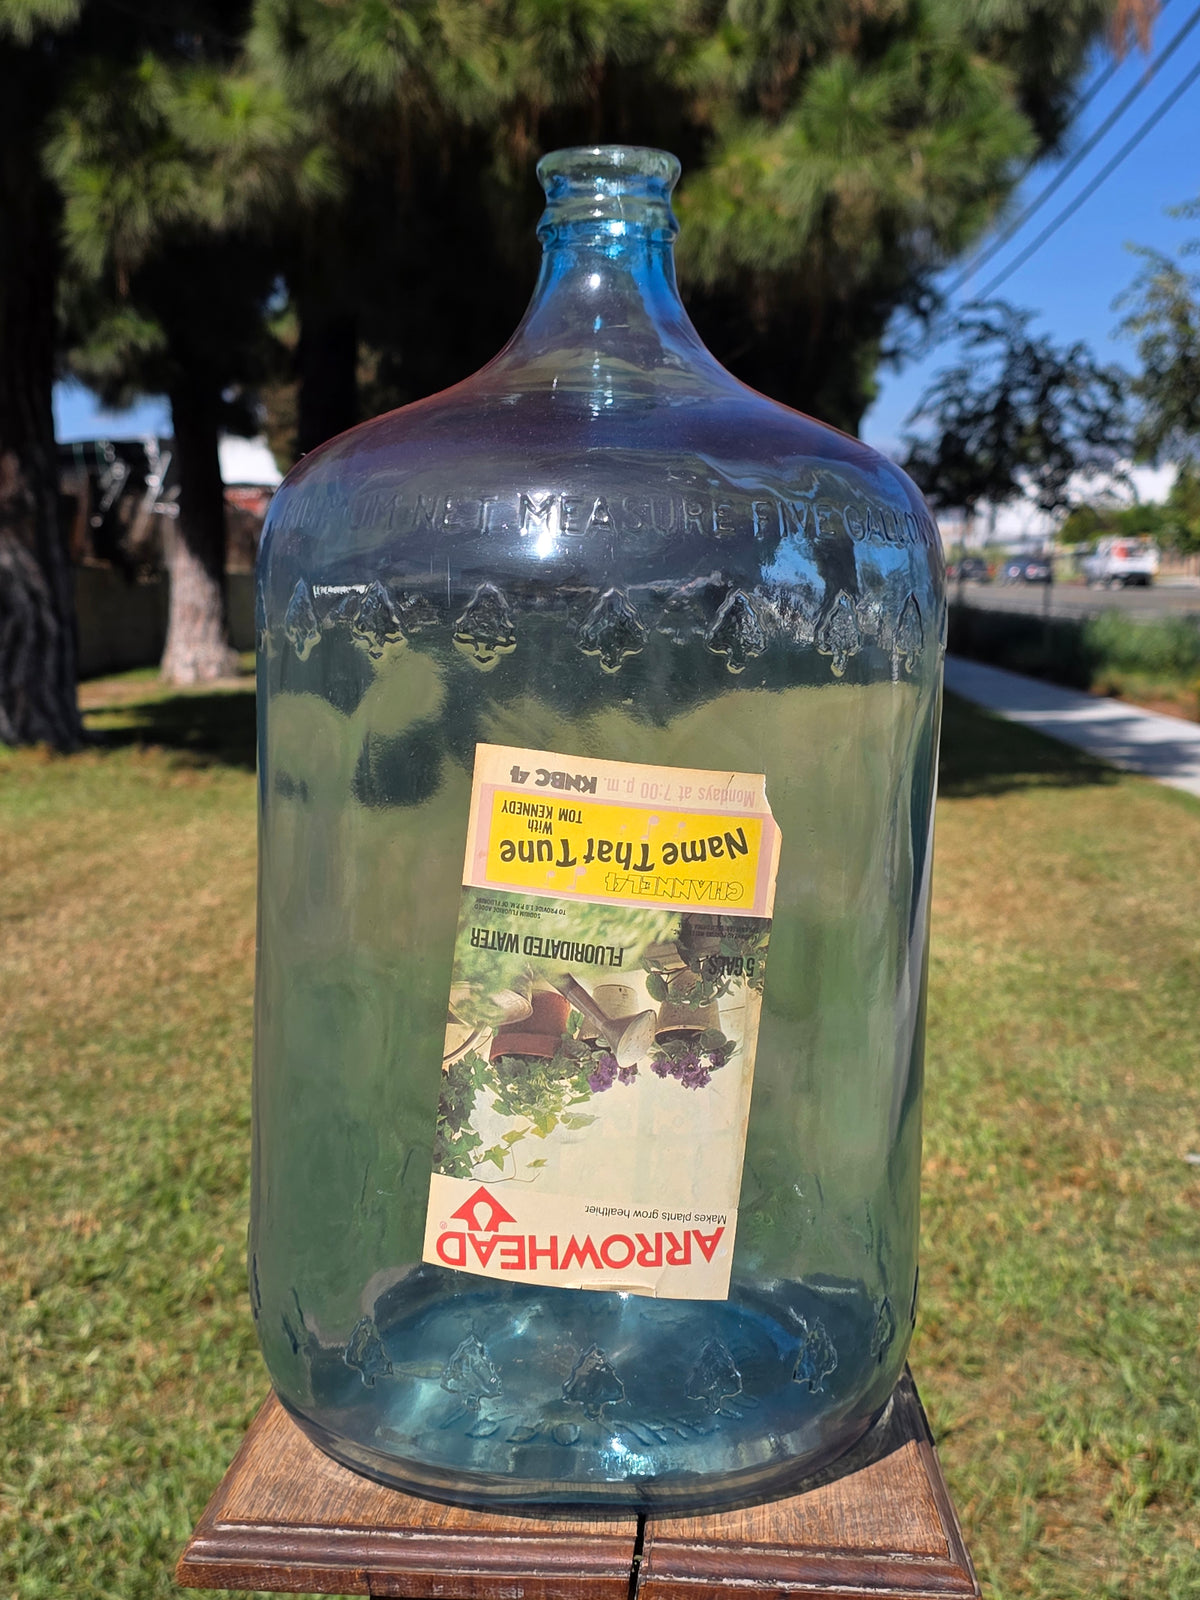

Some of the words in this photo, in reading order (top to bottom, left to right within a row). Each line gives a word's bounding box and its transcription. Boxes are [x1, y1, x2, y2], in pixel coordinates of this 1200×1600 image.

[517, 491, 735, 539] MEASURE
[751, 499, 836, 539] FIVE
[510, 765, 530, 784] 4
[535, 768, 597, 795] KNBC
[640, 782, 671, 801] 7:00
[678, 785, 692, 801] at
[698, 785, 755, 808] Mondays
[501, 799, 553, 820] KENNEDY
[558, 808, 583, 824] TOM
[528, 819, 553, 835] With
[500, 838, 577, 868] Tune
[583, 838, 655, 872] That
[661, 827, 749, 865] Name
[493, 906, 518, 916] FLUORIDE
[519, 911, 541, 919] SODIUM
[535, 904, 557, 914] PROVIDE
[470, 926, 519, 953] WATER
[523, 935, 624, 967] FLUORIDATED
[746, 957, 755, 977] 5
[584, 1205, 630, 1219] healthier.
[633, 1209, 659, 1219] grow
[661, 1211, 692, 1221] plants
[694, 1214, 727, 1225] Makes
[436, 1226, 726, 1270] ARROWHEAD
